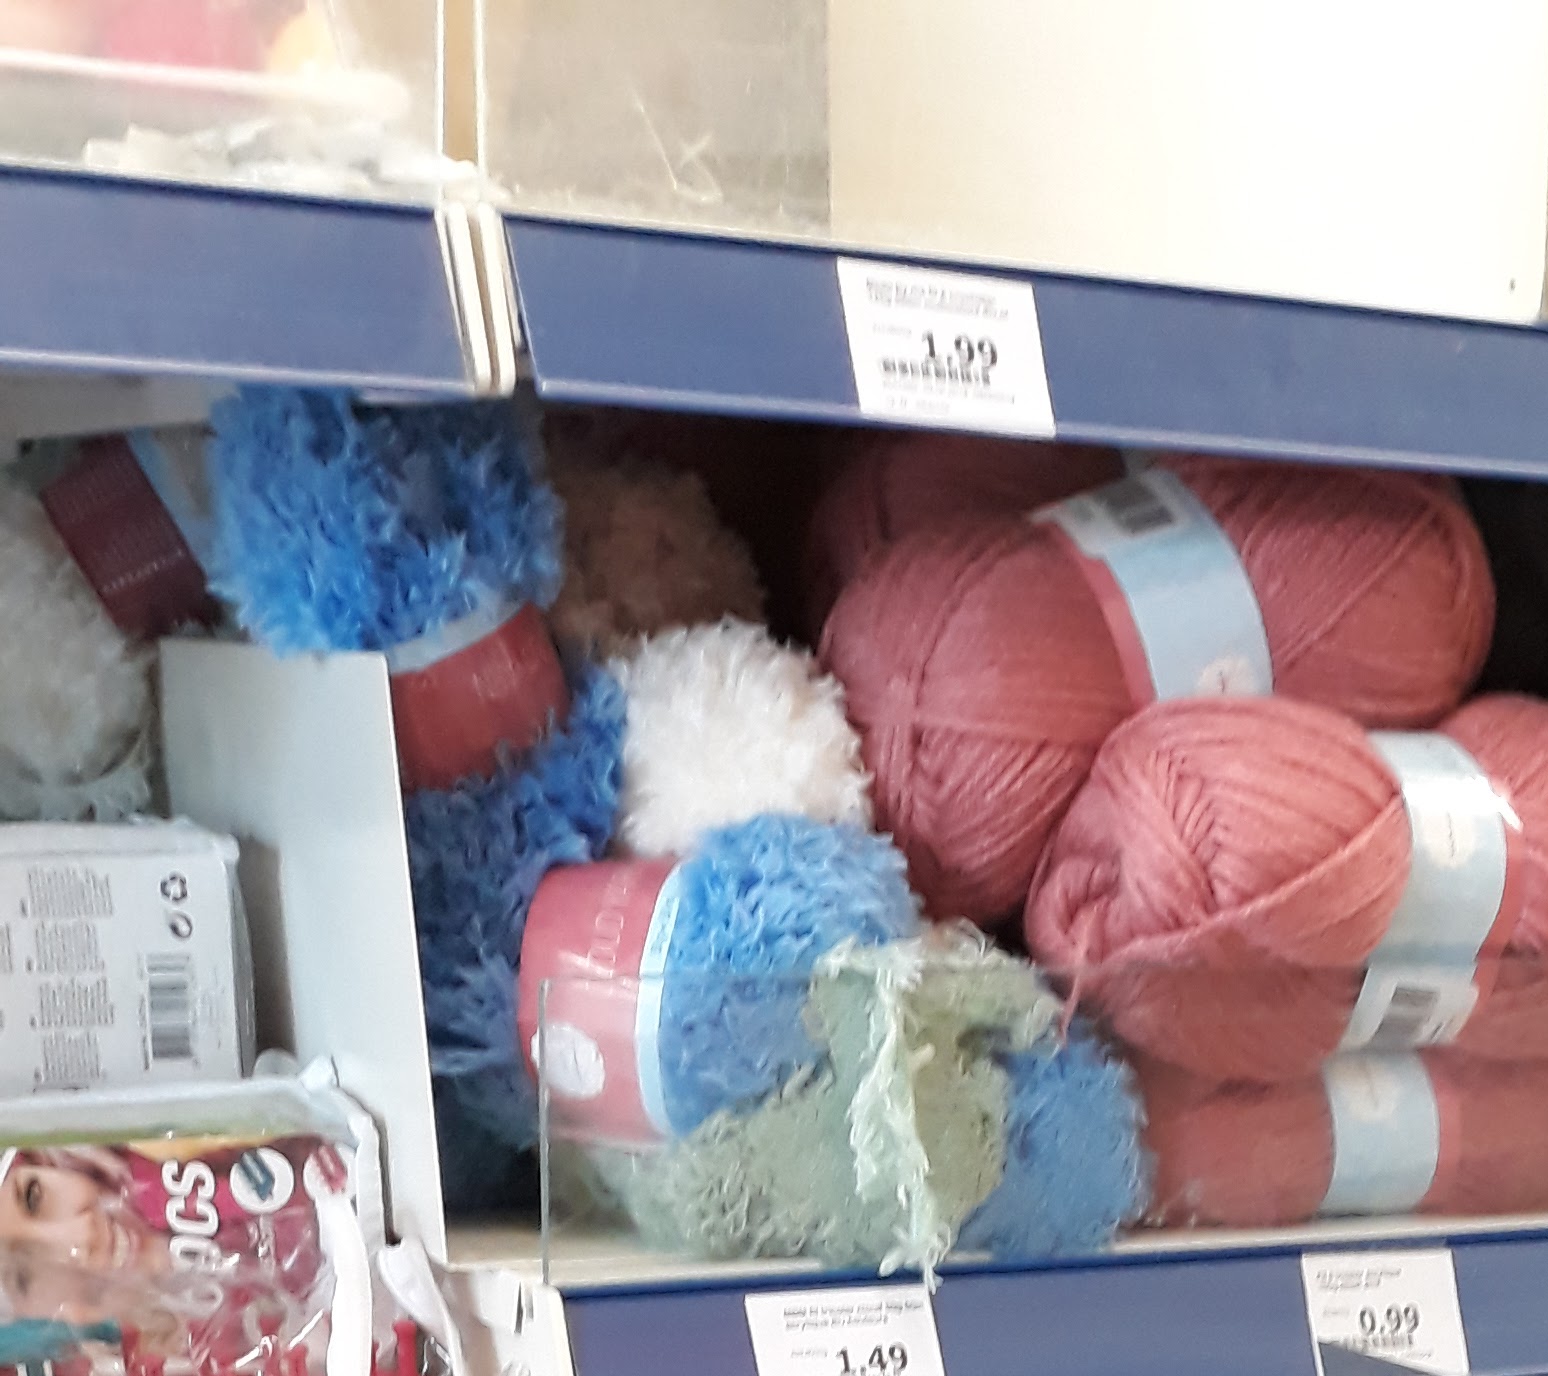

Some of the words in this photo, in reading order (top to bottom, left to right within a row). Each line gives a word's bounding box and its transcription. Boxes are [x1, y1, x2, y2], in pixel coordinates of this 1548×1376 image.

[921, 330, 999, 368] 1.99
[1359, 1302, 1421, 1336] 0.99
[835, 1341, 909, 1376] 1.49
